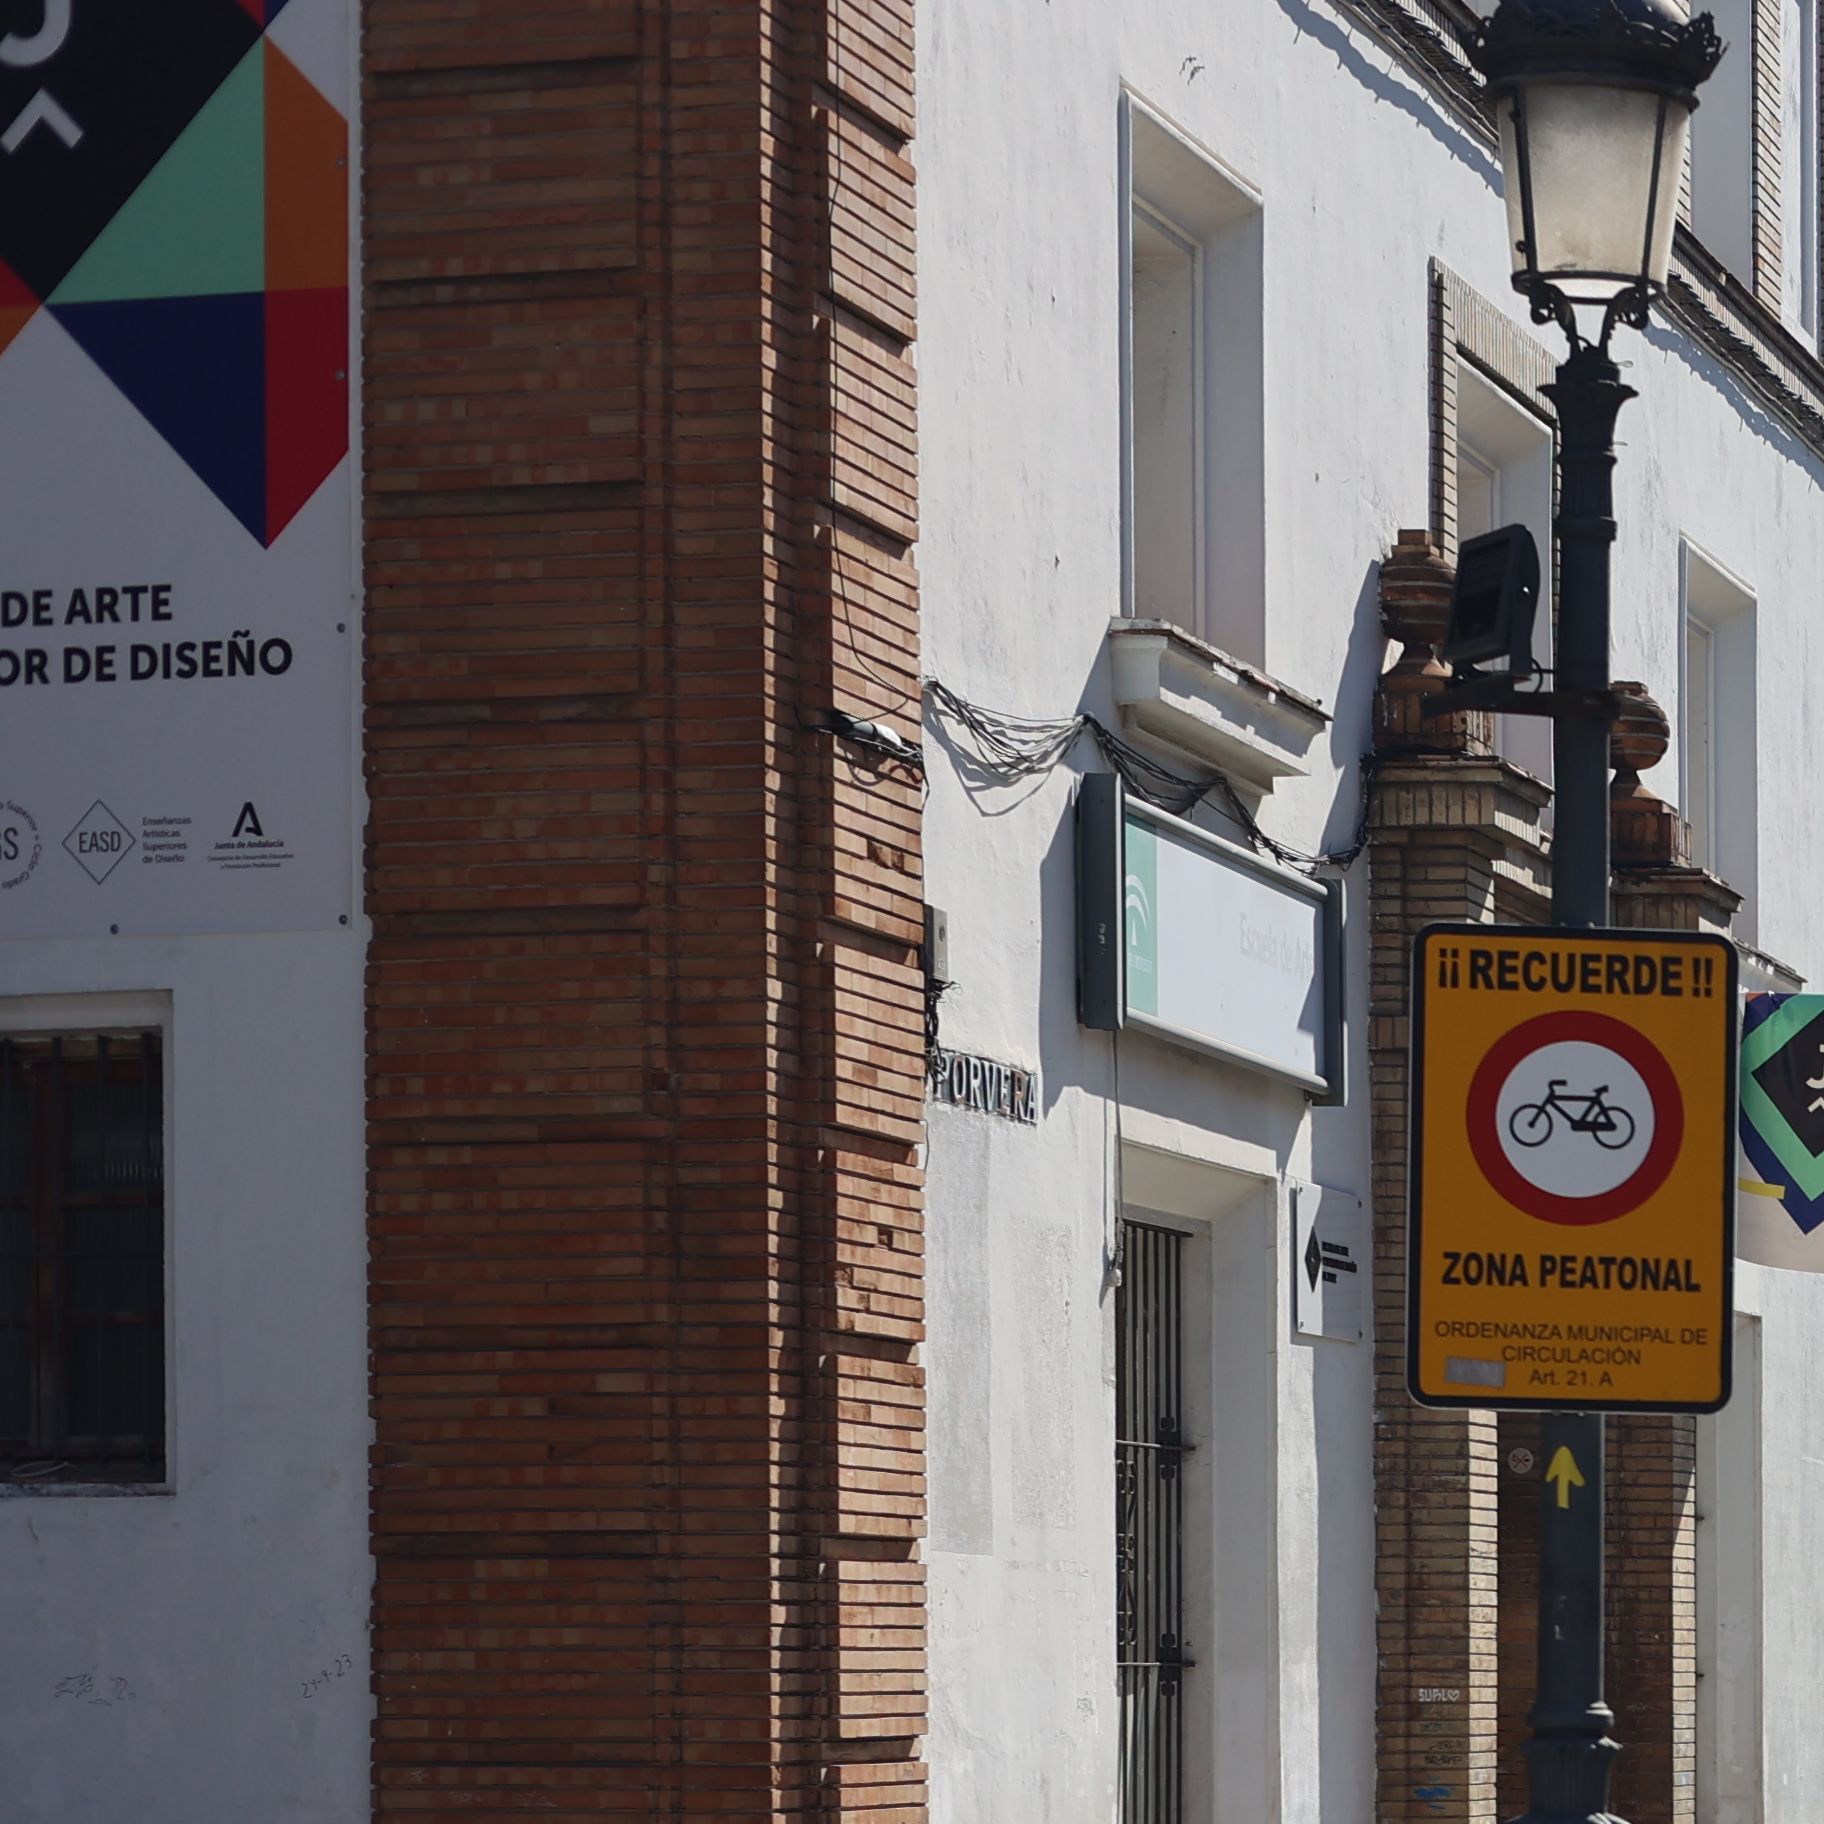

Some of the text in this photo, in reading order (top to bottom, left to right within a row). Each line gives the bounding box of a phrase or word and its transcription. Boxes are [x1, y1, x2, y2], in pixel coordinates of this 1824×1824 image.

[1, 584, 172, 627] DE ARTE
[63, 645, 116, 683] DE
[130, 630, 292, 680] DISEÑO
[79, 831, 121, 853] EASD
[214, 842, 235, 850] Junta
[142, 853, 184, 864] de Diseño
[933, 1052, 1038, 1121] PORVERA
[1441, 1252, 1701, 1293] ZONA PEATONAL
[1434, 1321, 1709, 1345] ORDENANZA MUNICIPAL DE
[1502, 1345, 1642, 1365] CIRCULACIÓN
[1528, 1369, 1614, 1387] Art. 21. A
